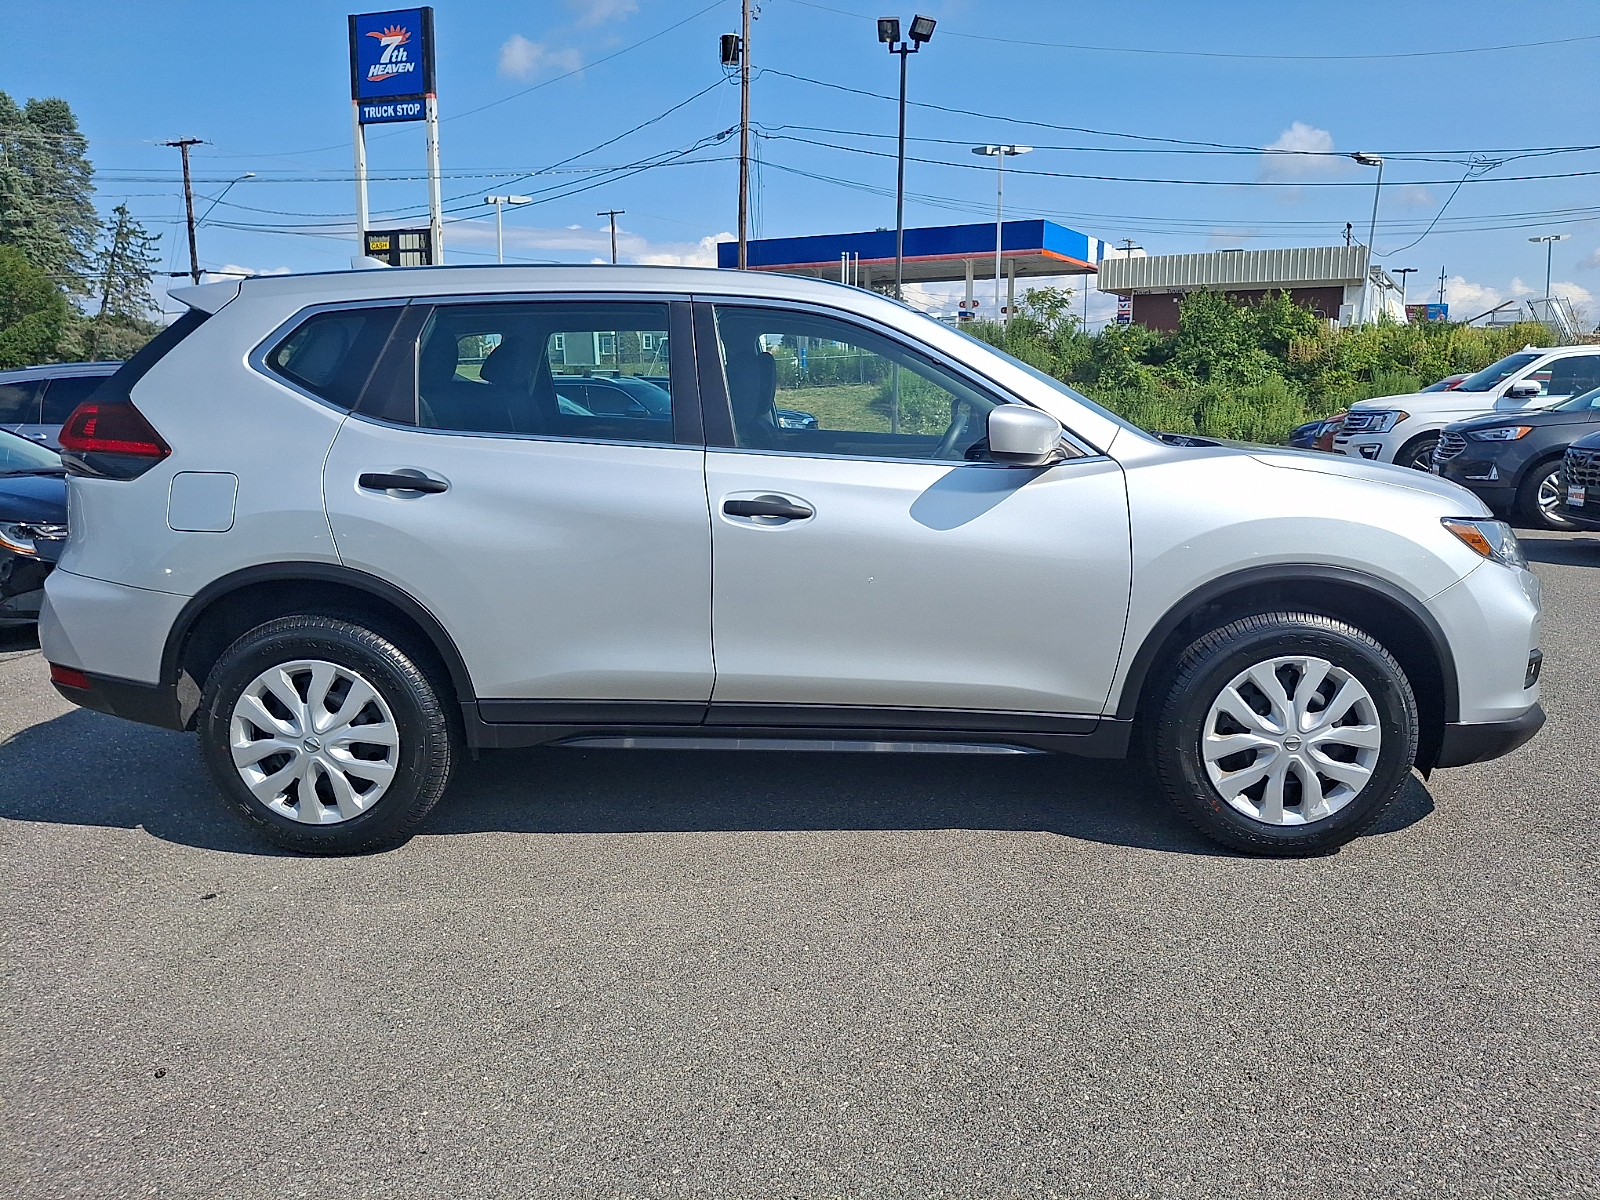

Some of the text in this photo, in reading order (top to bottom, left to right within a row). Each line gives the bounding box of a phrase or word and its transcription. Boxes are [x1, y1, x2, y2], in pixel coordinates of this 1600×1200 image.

[380, 36, 407, 63] 7th
[368, 62, 415, 77] HEAVEN
[364, 103, 420, 118] TRUCK STOP
